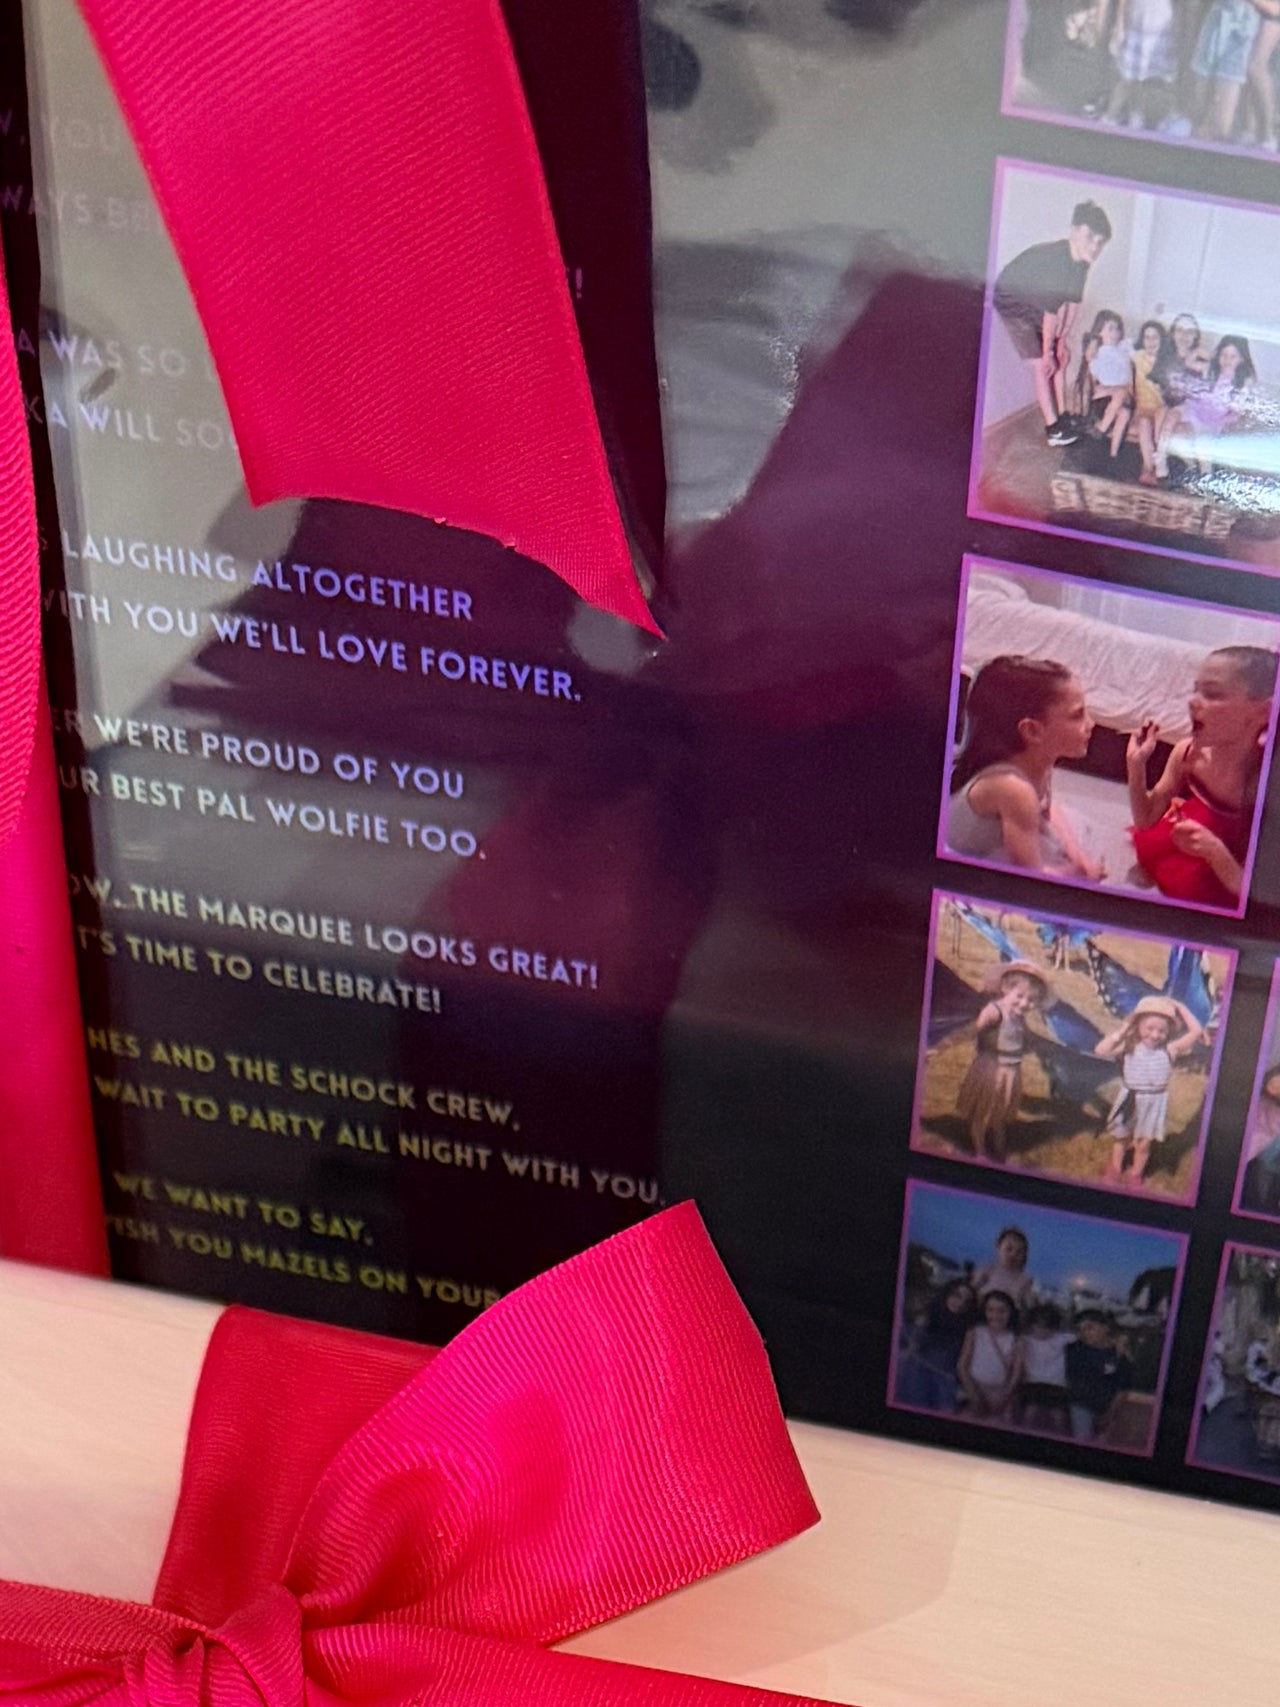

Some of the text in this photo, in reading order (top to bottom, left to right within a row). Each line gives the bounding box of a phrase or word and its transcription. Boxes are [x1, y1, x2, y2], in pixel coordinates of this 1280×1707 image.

[48, 330, 122, 369] WAS
[137, 346, 186, 378] SO
[79, 402, 161, 443] WILL
[61, 531, 237, 582] LAUGHING
[252, 560, 473, 621] ALTOGETHER
[123, 600, 199, 638] YOU
[211, 612, 306, 655] WE'LL
[319, 630, 408, 673] LOVE
[420, 646, 582, 702] FOREVER.
[94, 714, 189, 755] WE'RE
[201, 731, 320, 775] PROUD
[333, 753, 378, 785] OF
[391, 761, 464, 799] YOU
[110, 773, 185, 811] BEST
[197, 786, 256, 823] PAL
[266, 798, 390, 844] WOLFIE
[126, 934, 198, 973] TIME
[205, 948, 253, 981] TO
[263, 960, 442, 1014] CELEBRATE!
[130, 883, 188, 919] THE
[198, 894, 354, 947] MARQUEE
[364, 923, 477, 967] LOOKS
[488, 946, 598, 990] GREAT!
[151, 1041, 216, 1073] AND
[225, 1053, 281, 1087] THE
[290, 1062, 416, 1111] SCHOCK
[94, 1075, 166, 1111] WAIT
[175, 1091, 220, 1122] TO
[228, 1103, 324, 1142] PARTY
[336, 1118, 391, 1153] ALL
[398, 1131, 493, 1172] NIGHT
[502, 1150, 581, 1190] WITH
[114, 1171, 155, 1200] WE
[163, 1181, 248, 1220] WANT
[258, 1200, 302, 1229] TO
[168, 1227, 233, 1260] YOU
[239, 1242, 351, 1284] MAZELS
[359, 1265, 408, 1295] ON
